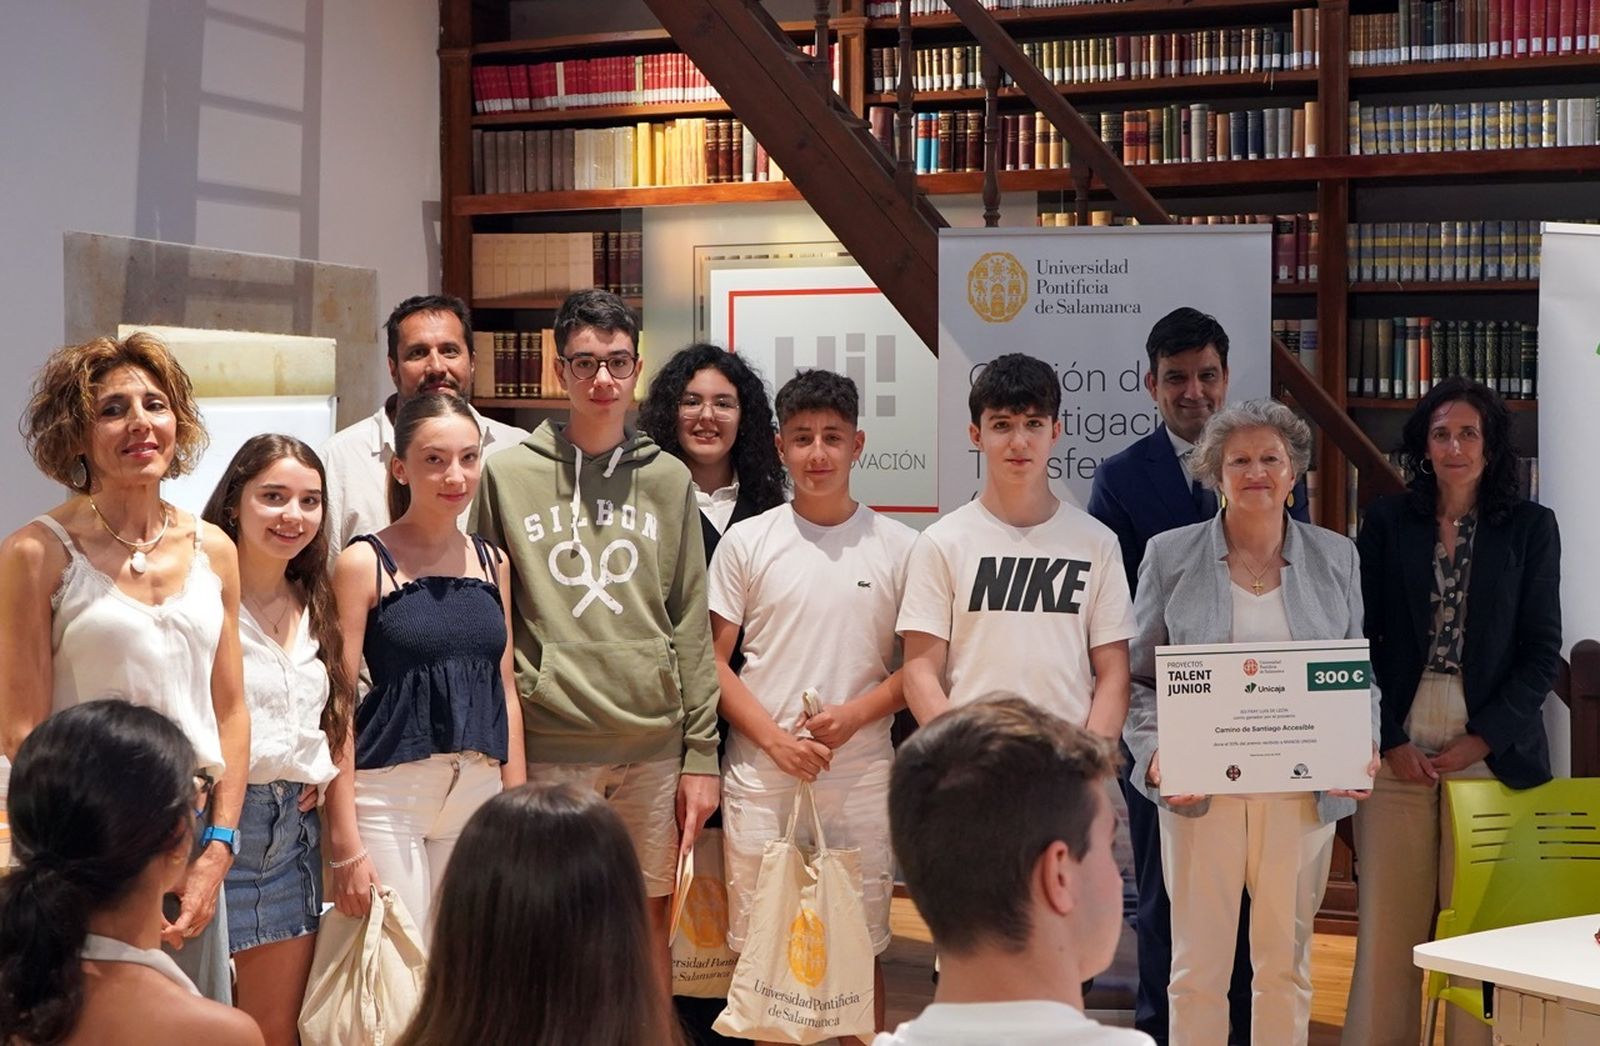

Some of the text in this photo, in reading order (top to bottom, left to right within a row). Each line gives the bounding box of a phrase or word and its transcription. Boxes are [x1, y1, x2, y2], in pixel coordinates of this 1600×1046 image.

[1036, 259, 1129, 275] Universidad
[1036, 279, 1109, 295] Pontificia
[1034, 299, 1142, 315] de Salamanca
[1119, 360, 1149, 392] d
[523, 499, 658, 543] SILBON
[968, 556, 1092, 614] NIKE
[1166, 661, 1204, 669] PROYECTOS
[1167, 669, 1213, 682] TALENT
[1314, 669, 1365, 684] 300 €
[1167, 682, 1212, 697] JUNIOR
[1257, 685, 1286, 694] Unicaja
[1252, 725, 1282, 733] Santiago
[1282, 723, 1315, 731] Accesible
[754, 979, 861, 1012] Universidad Pontificia
[767, 1003, 840, 1028] de Salamanca
